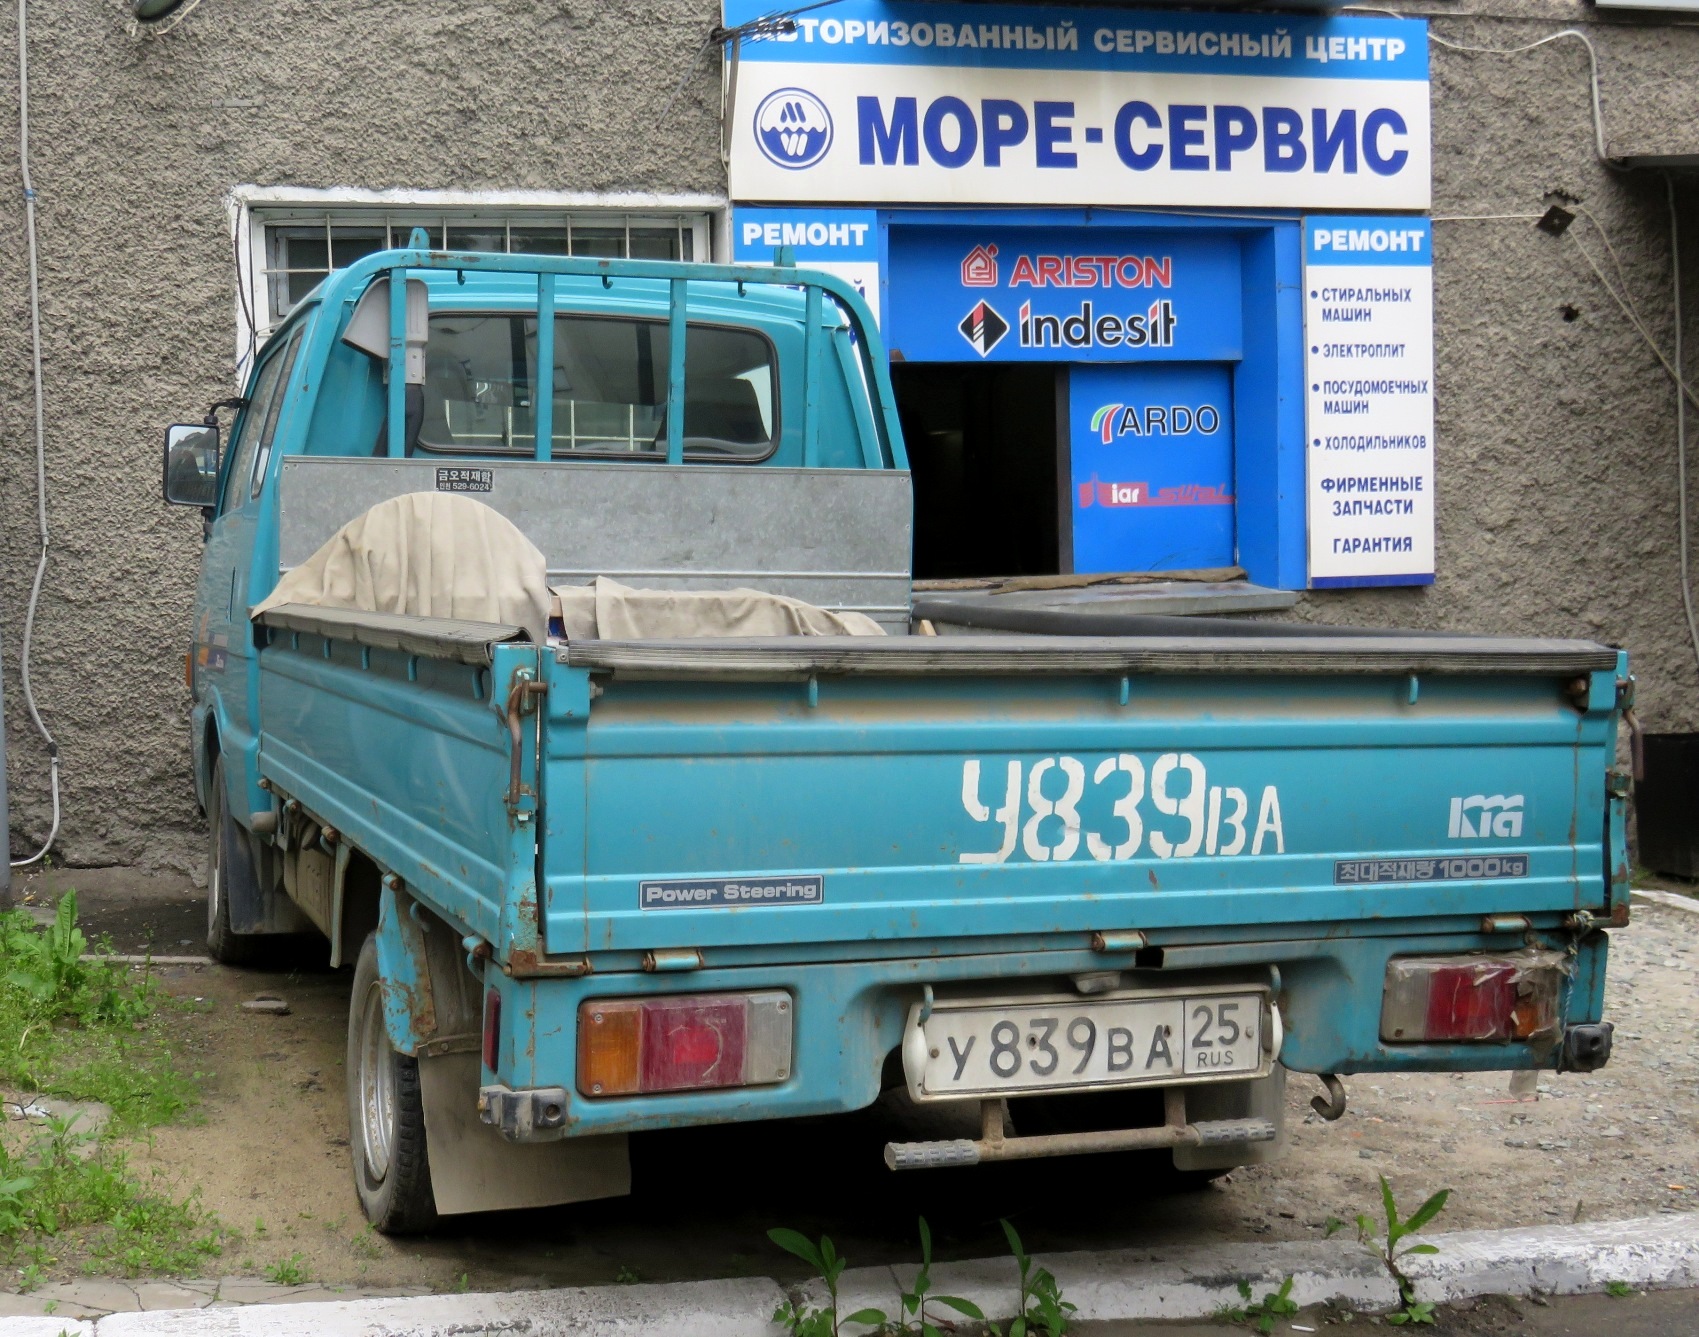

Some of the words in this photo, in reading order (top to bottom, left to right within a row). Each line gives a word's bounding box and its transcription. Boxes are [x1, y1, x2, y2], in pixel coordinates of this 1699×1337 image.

[1093, 21, 1292, 58] СЕРВИСНЫЙ
[1306, 36, 1406, 63] ЦЕНТР
[857, 95, 1409, 177] МОРЕ-СЕРВИС
[743, 222, 869, 246] РЕМОНТ
[1313, 229, 1425, 252] РЕМОНТ
[1008, 255, 1172, 288] ARISTON
[1321, 287, 1412, 303] СТИРАЛЬНЫХ
[1321, 307, 1372, 322] МАШИН
[1323, 343, 1406, 358] ЭЛЕКТРОПЛИТ
[1323, 379, 1428, 397] ПОСУДОМОЕЧНЫХ
[1323, 399, 1370, 415] МАШИН
[1117, 404, 1220, 436] ARDO
[1324, 434, 1427, 452] ХОЛОДИЛЬНИКОВ
[1111, 483, 1140, 504] iar
[1320, 476, 1423, 493] ФИРМЕННЫЕ
[1332, 499, 1413, 516] ЗАПЧАСТИ
[1333, 536, 1412, 554] ГАРАНТИЯ
[1438, 857, 1524, 879] 1000kg
[646, 886, 718, 903] Power
[723, 882, 817, 900] Steering
[1192, 1003, 1240, 1048] 25
[1197, 1050, 1234, 1068] RUS
